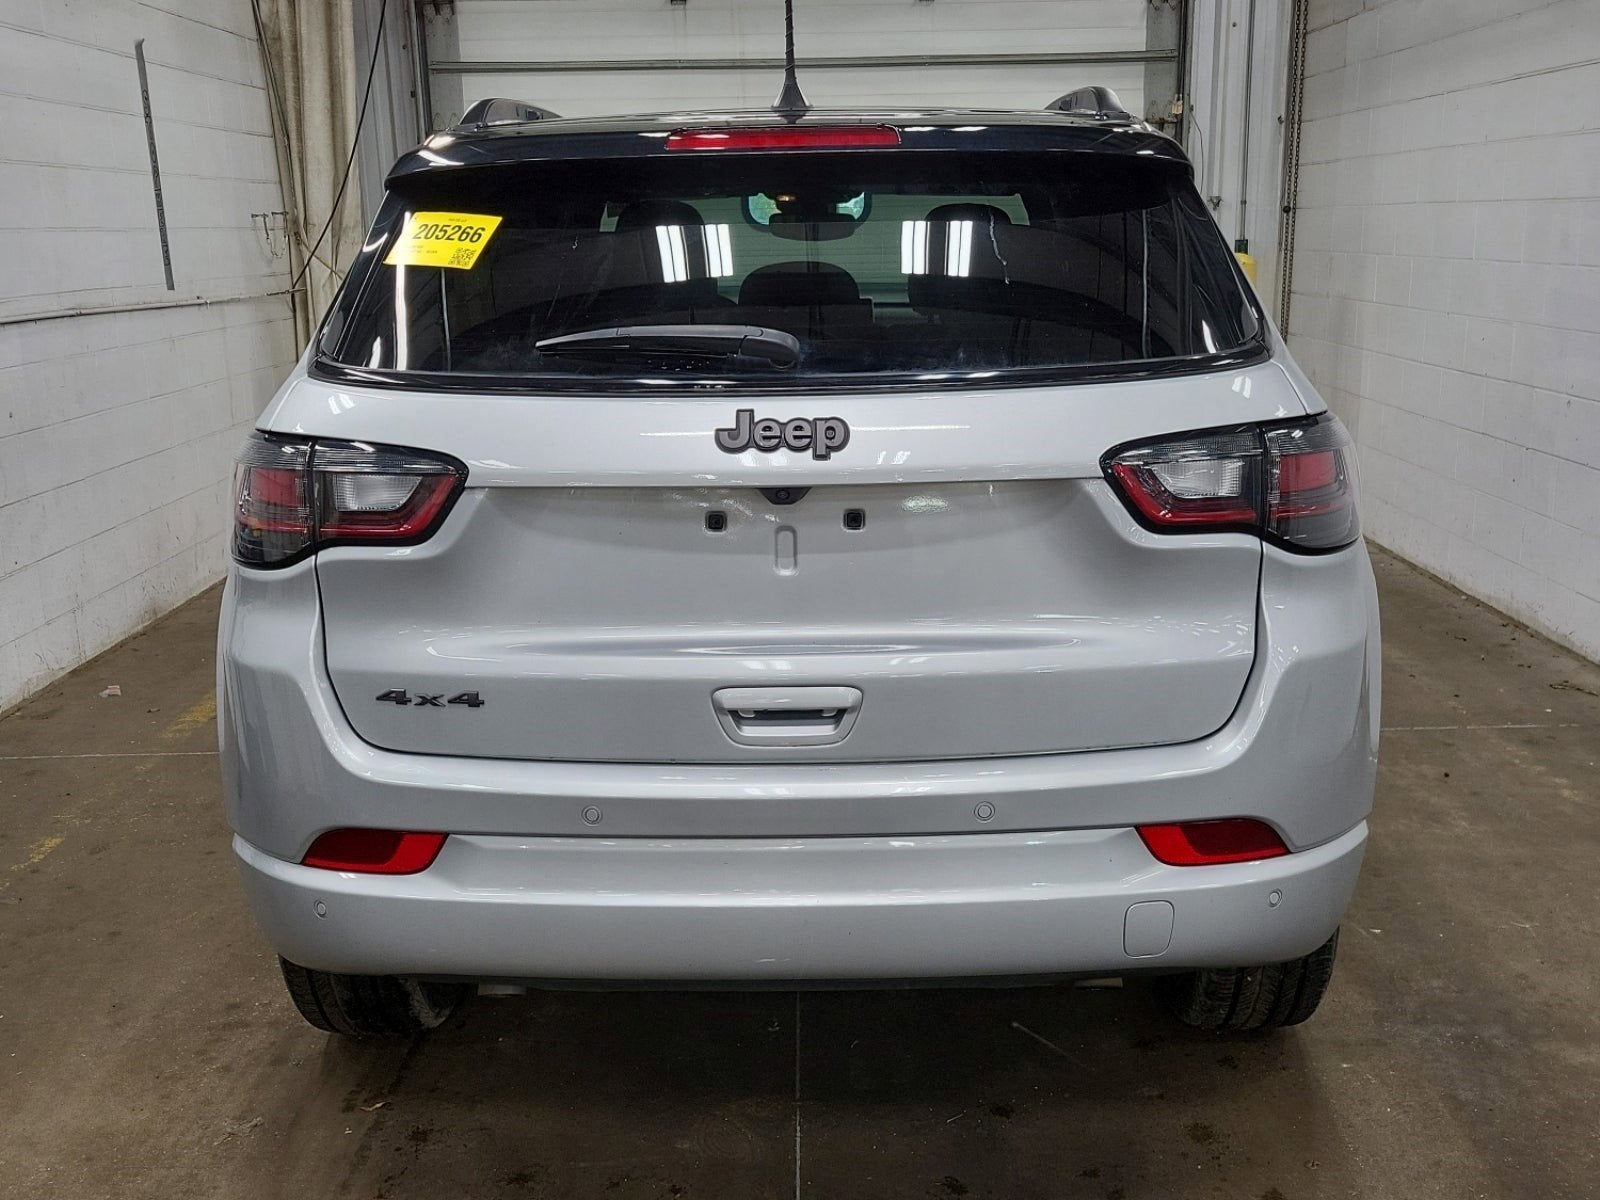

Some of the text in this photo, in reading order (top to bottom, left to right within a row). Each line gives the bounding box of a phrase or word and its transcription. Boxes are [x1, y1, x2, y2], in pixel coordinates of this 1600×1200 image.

[412, 223, 486, 243] 205266
[715, 409, 850, 461] Jeep
[376, 688, 485, 707] 4x4
